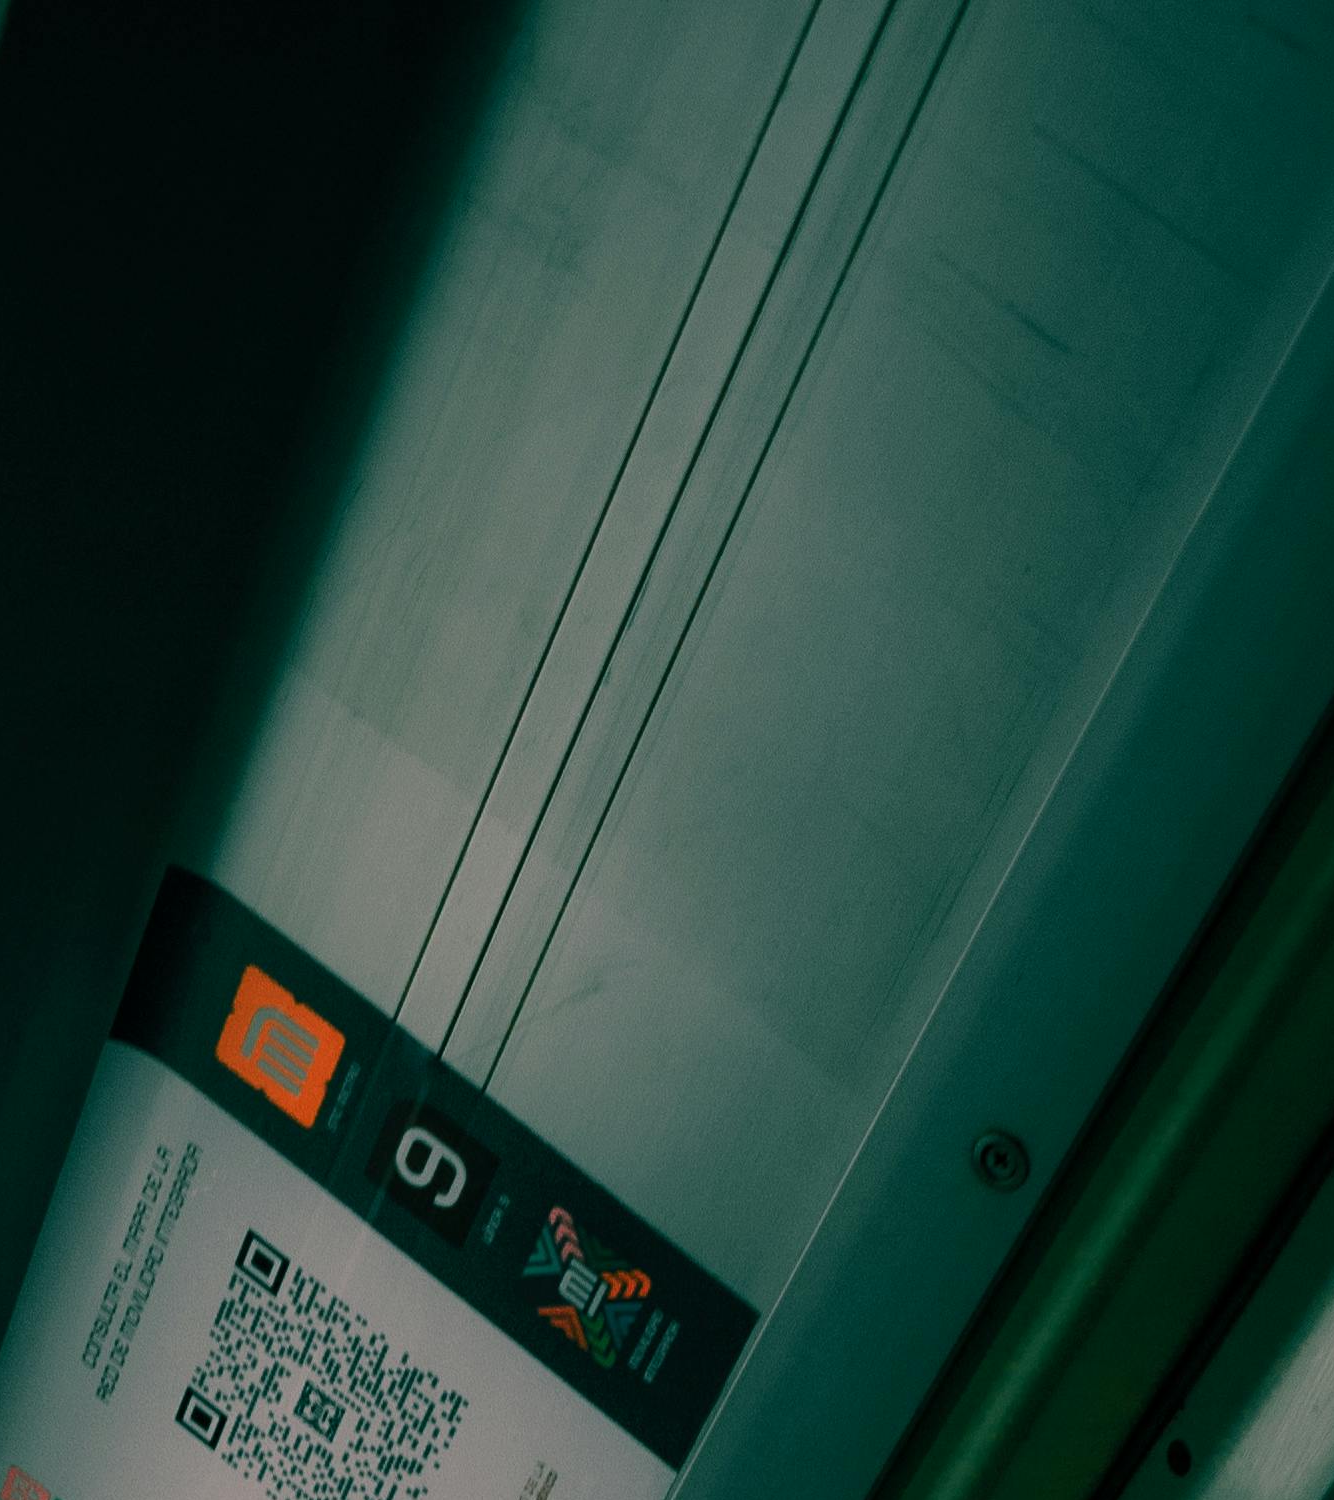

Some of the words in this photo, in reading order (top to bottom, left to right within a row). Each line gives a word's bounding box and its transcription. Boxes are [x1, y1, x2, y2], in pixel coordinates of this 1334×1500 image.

[155, 1142, 199, 1246] INTEGRADA
[394, 1126, 468, 1209] 9
[82, 1280, 118, 1369] CONSULTA
[113, 1259, 132, 1283] EL
[123, 1200, 148, 1253] MAPA
[142, 1173, 162, 1202] DE
[154, 1146, 171, 1176] LA
[119, 1244, 164, 1340] MOVILIDAD
[96, 1364, 119, 1402] RED
[110, 1338, 129, 1367] DE
